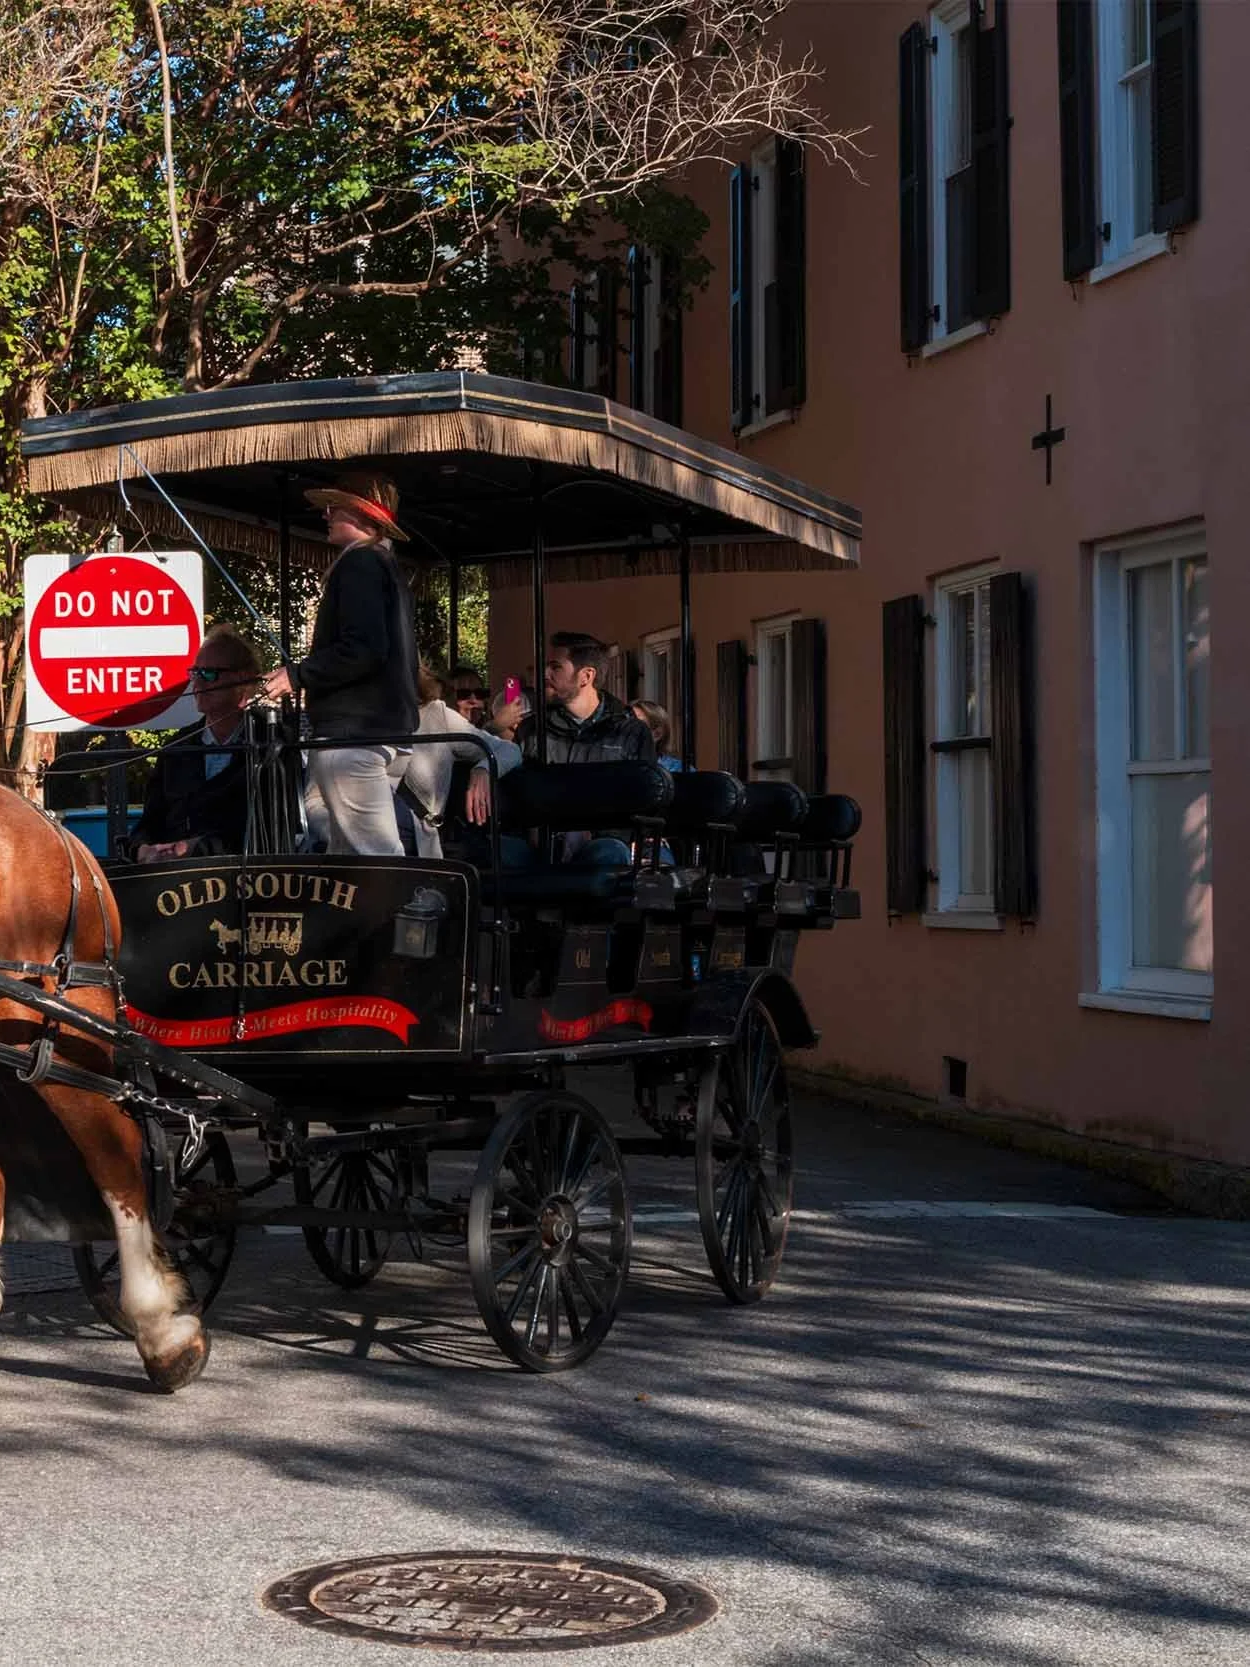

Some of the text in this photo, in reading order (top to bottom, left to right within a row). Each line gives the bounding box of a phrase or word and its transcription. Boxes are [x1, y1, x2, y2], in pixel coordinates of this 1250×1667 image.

[55, 590, 174, 618] DO NOT
[67, 667, 163, 694] ENTER
[156, 872, 359, 917] OLD SOUTH
[167, 959, 349, 989] CARRIAGE
[134, 1002, 399, 1042] Where Histor Meets Hospitality
